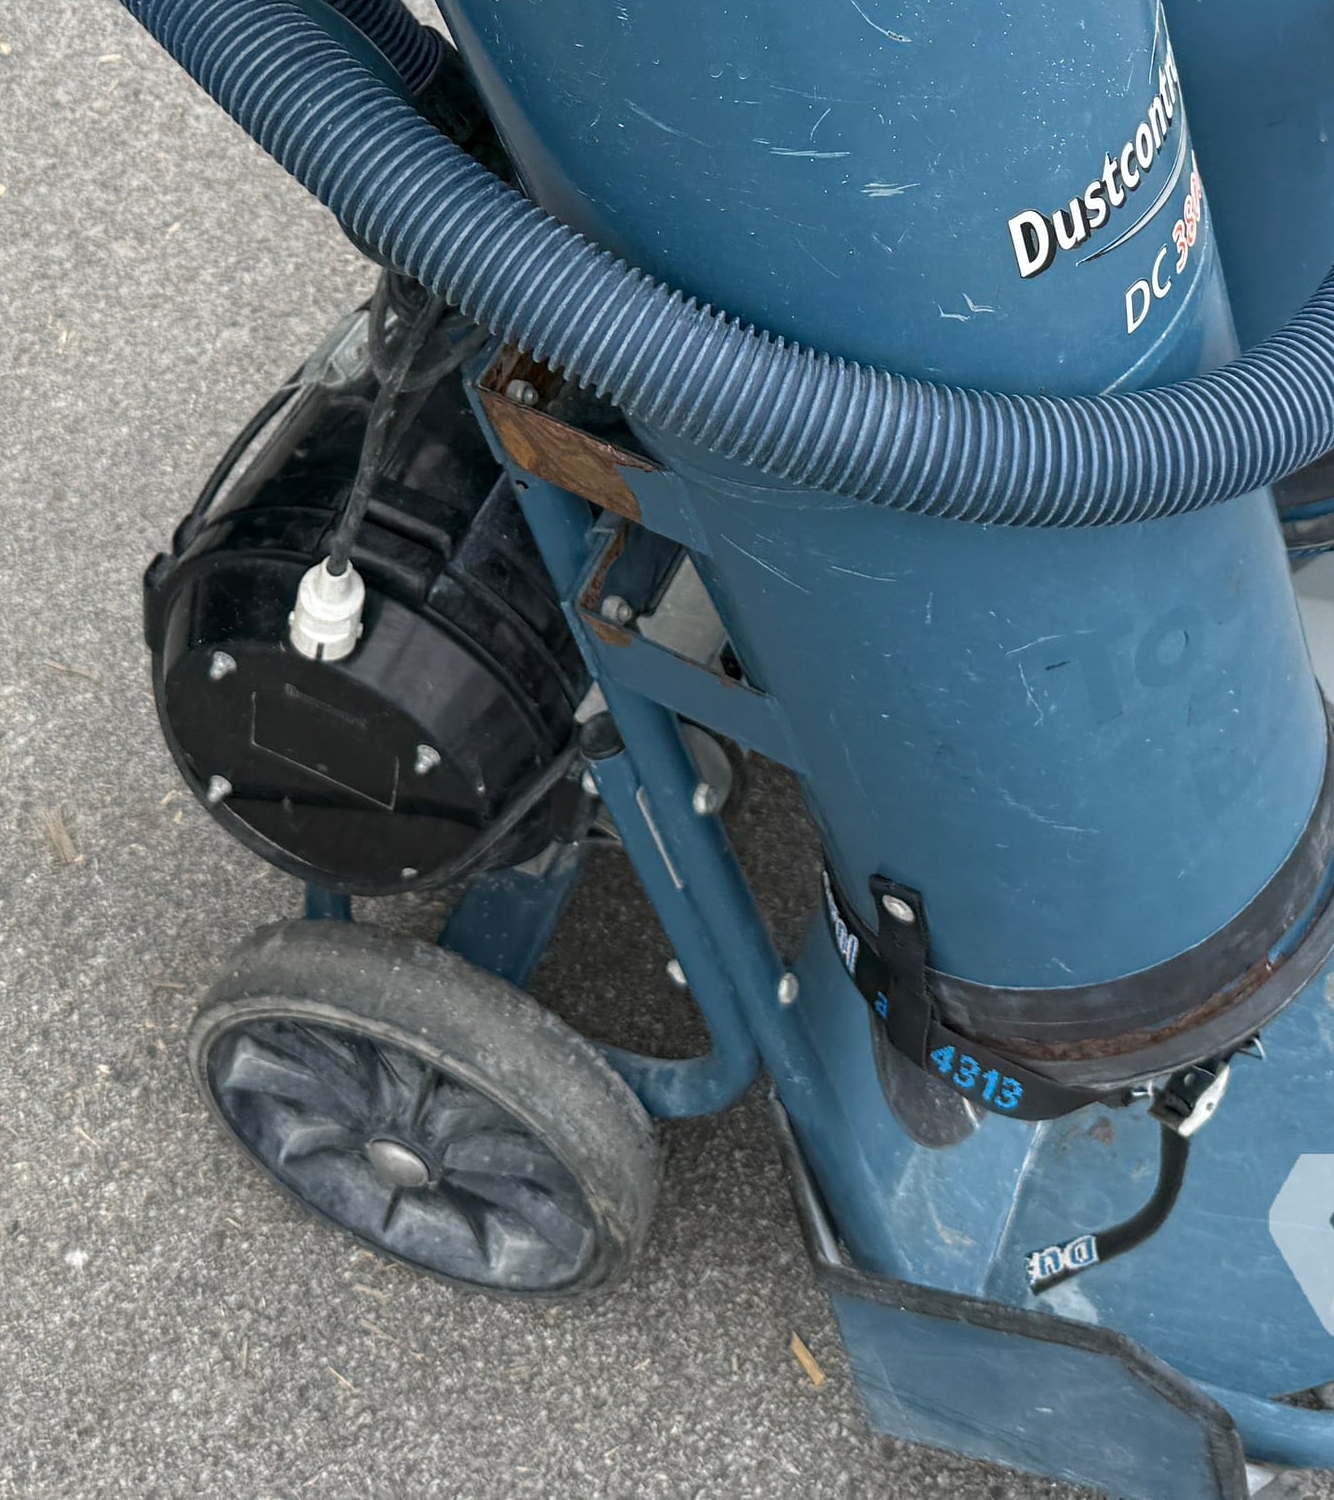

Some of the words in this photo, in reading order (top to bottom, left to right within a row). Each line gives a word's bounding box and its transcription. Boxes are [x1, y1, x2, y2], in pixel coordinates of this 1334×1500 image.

[1124, 243, 1172, 334] DC
[930, 1045, 1024, 1109] 4313
[1026, 1234, 1099, 1285] DU
